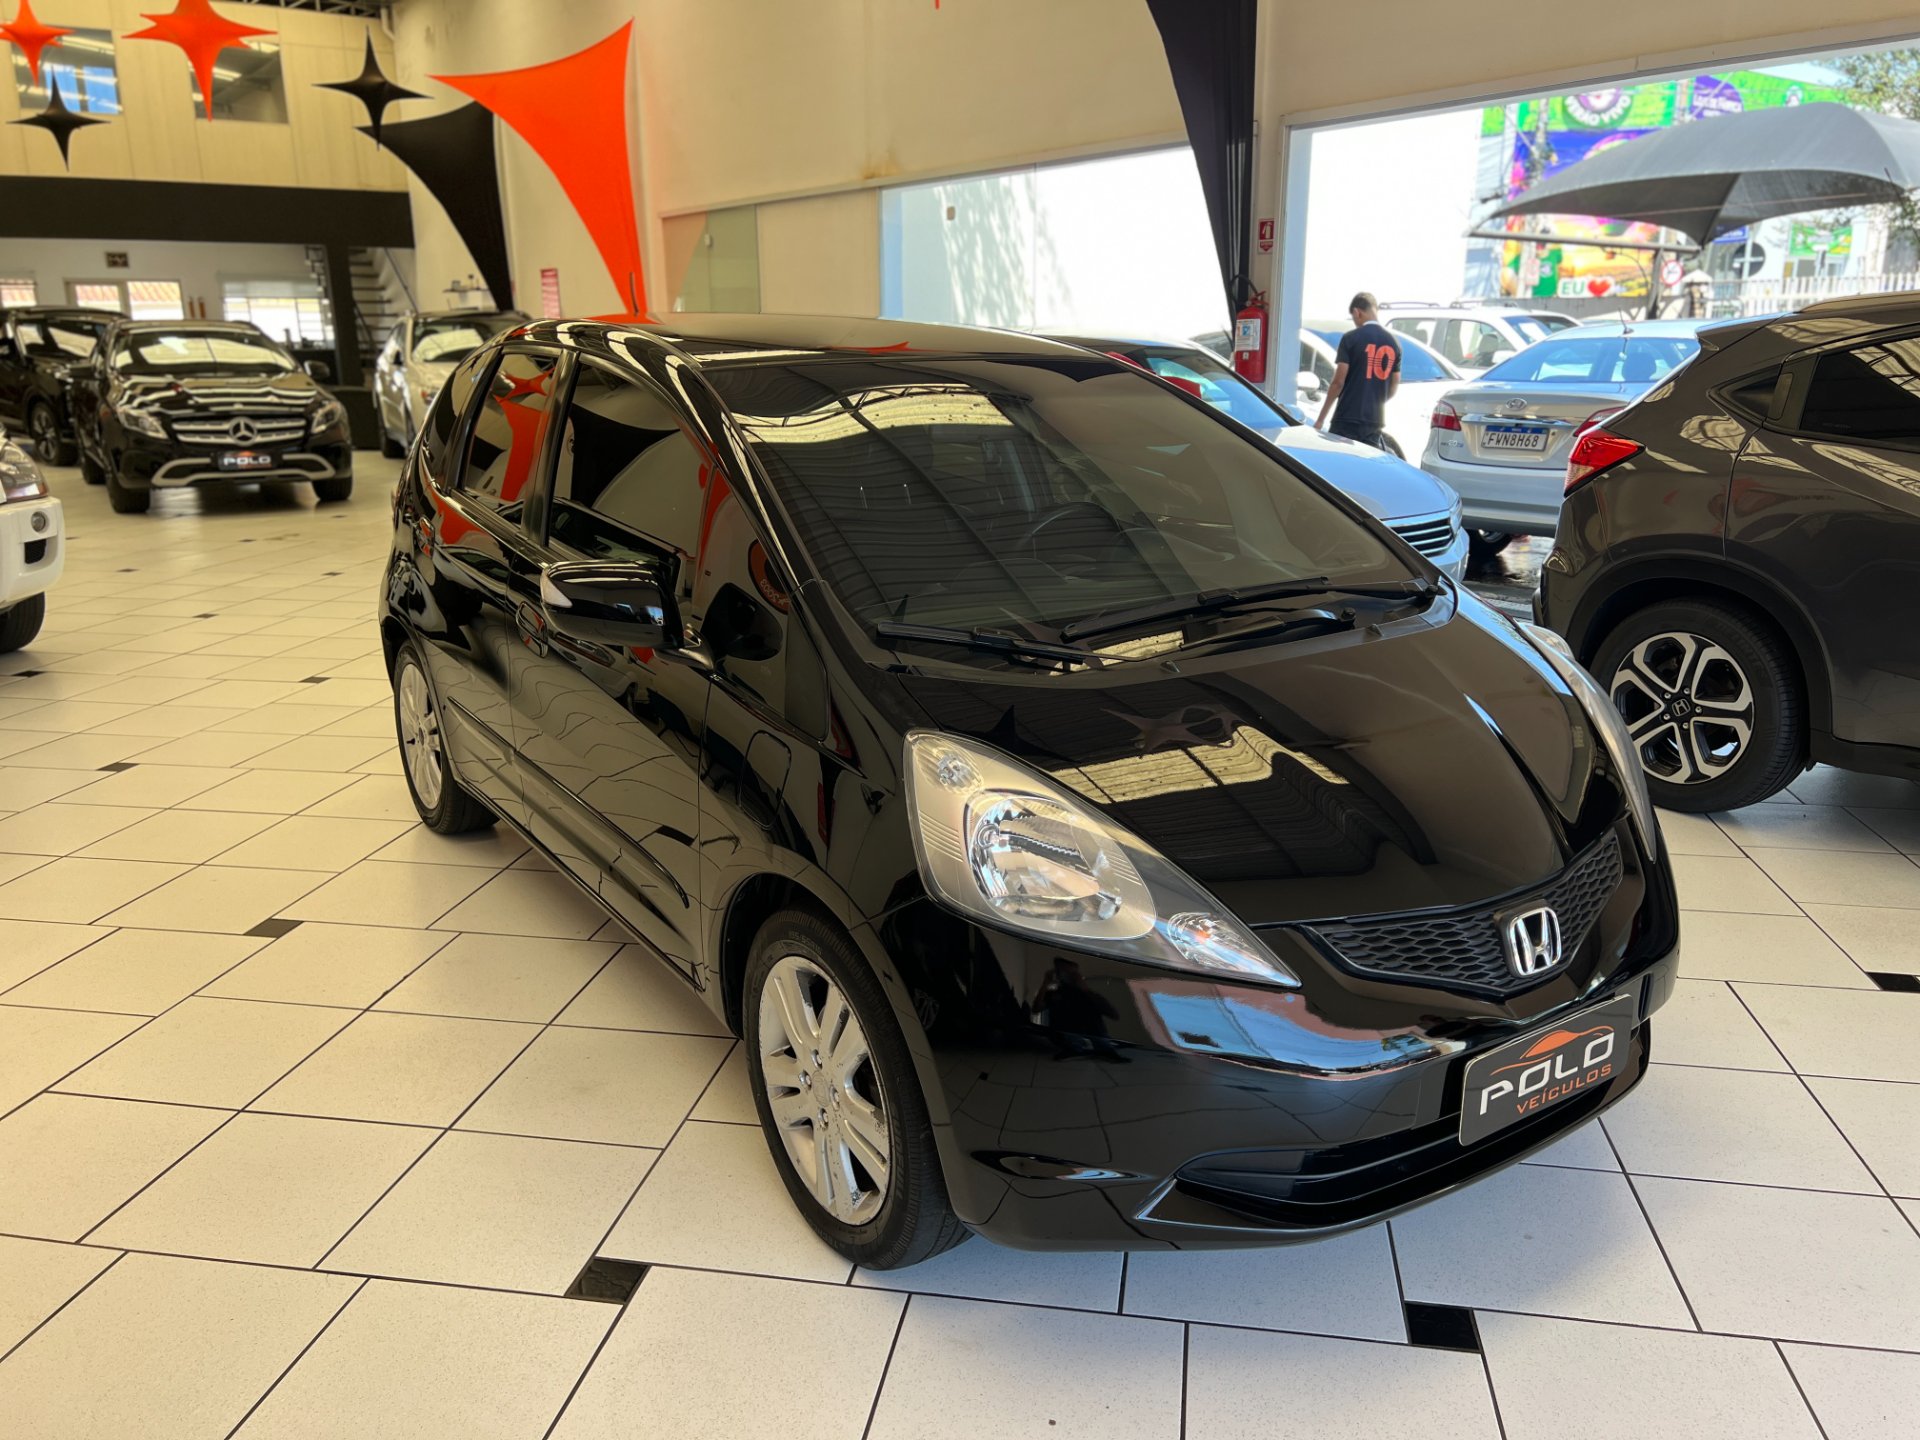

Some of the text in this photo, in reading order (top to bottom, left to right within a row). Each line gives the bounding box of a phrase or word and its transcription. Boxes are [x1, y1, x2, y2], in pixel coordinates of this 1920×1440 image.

[1561, 280, 1585, 295] EU
[1365, 343, 1396, 380] 10
[1487, 432, 1540, 448] FWN8H68
[223, 455, 271, 466] POLO
[1479, 1032, 1615, 1115] POLO
[1516, 1063, 1613, 1115] VEÍCULOS
